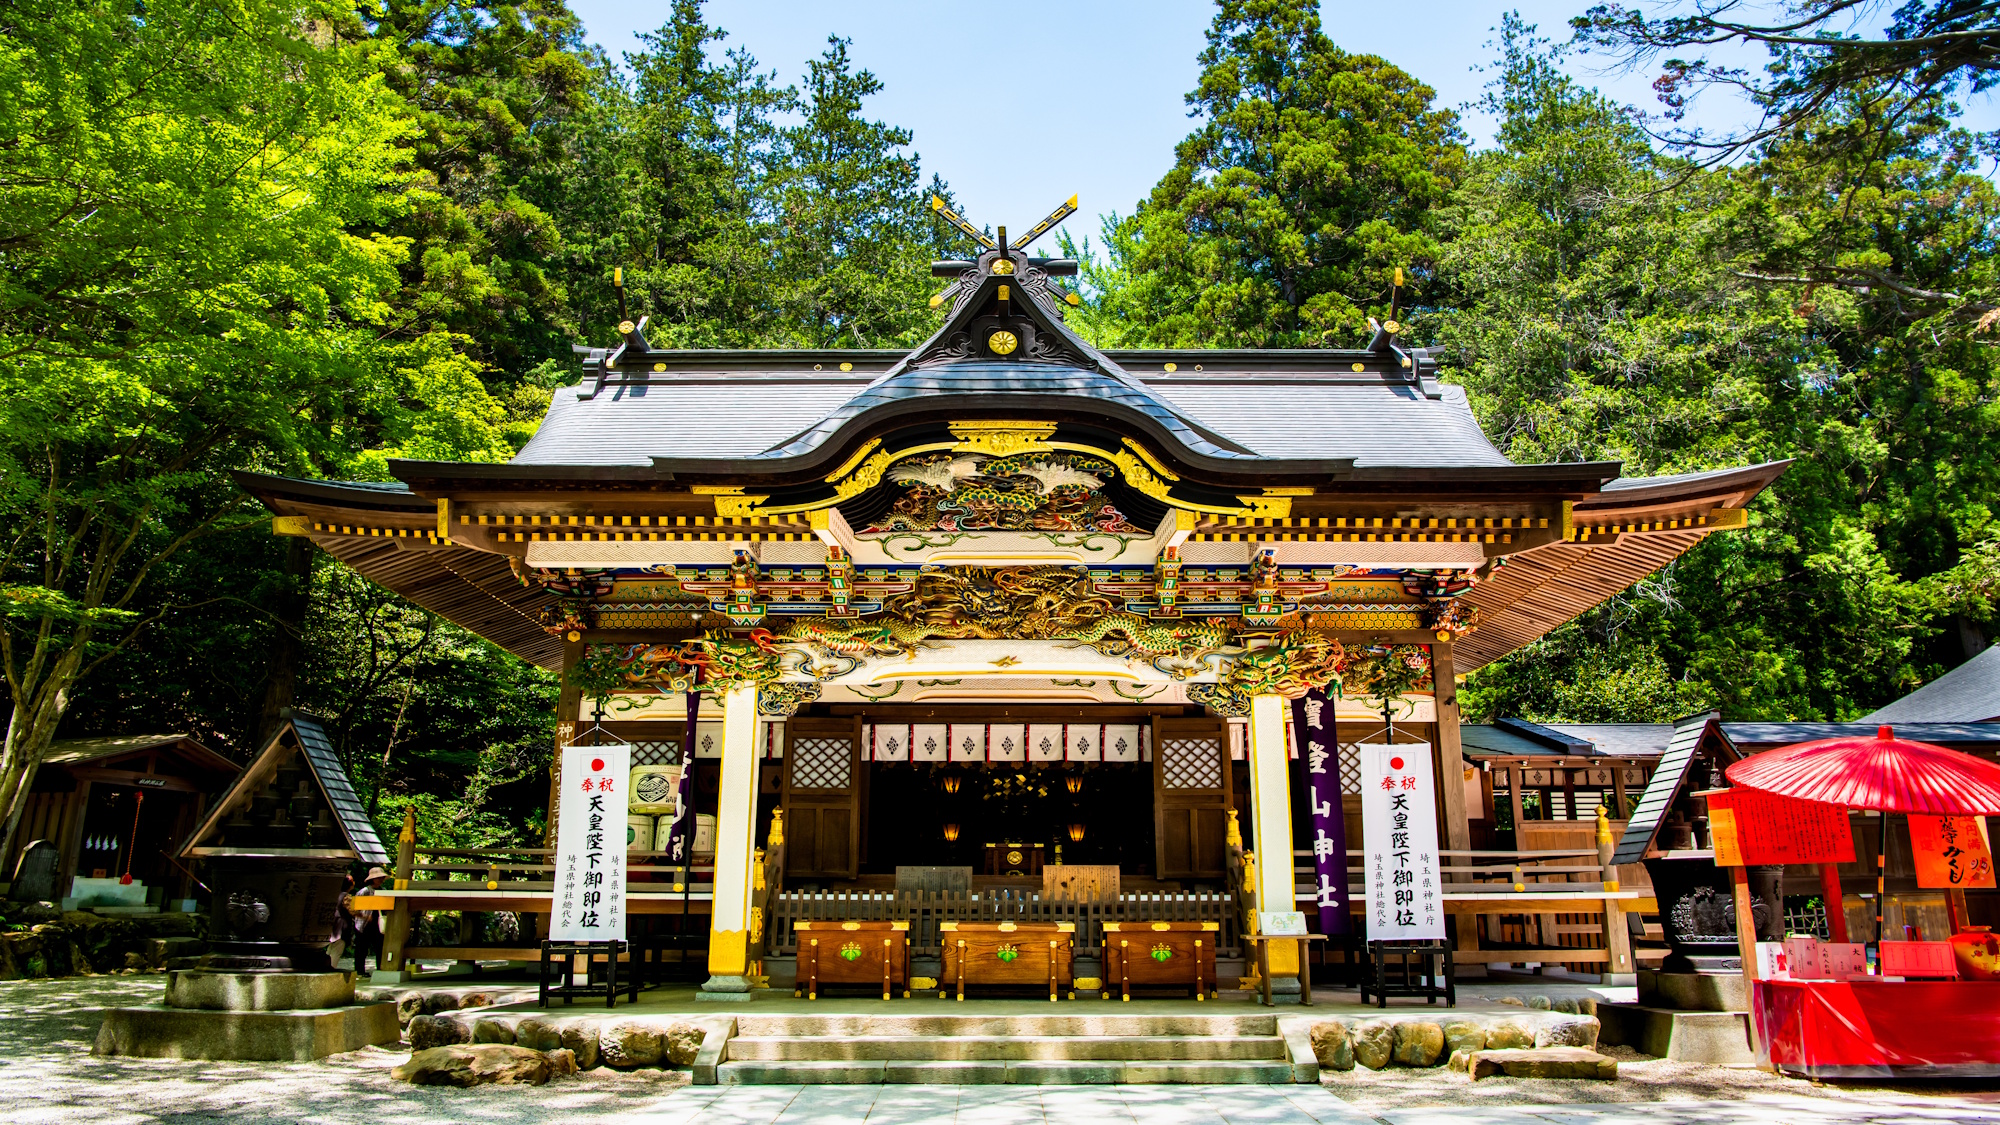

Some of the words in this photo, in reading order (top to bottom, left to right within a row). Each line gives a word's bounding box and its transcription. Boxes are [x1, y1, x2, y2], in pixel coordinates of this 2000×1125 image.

[580, 777, 614, 793] 奉祝
[1380, 776, 1416, 791] 奉祝
[561, 854, 577, 928] 埼玉県神社総代会
[579, 795, 605, 928] 天皇陛下御即位
[608, 855, 620, 928] 埼玉県神社庁
[1374, 854, 1387, 928] 埼玉県神社総代会
[1390, 794, 1417, 927] 天皇陛下御即位
[1420, 854, 1435, 926] 埼玉県神社庁
